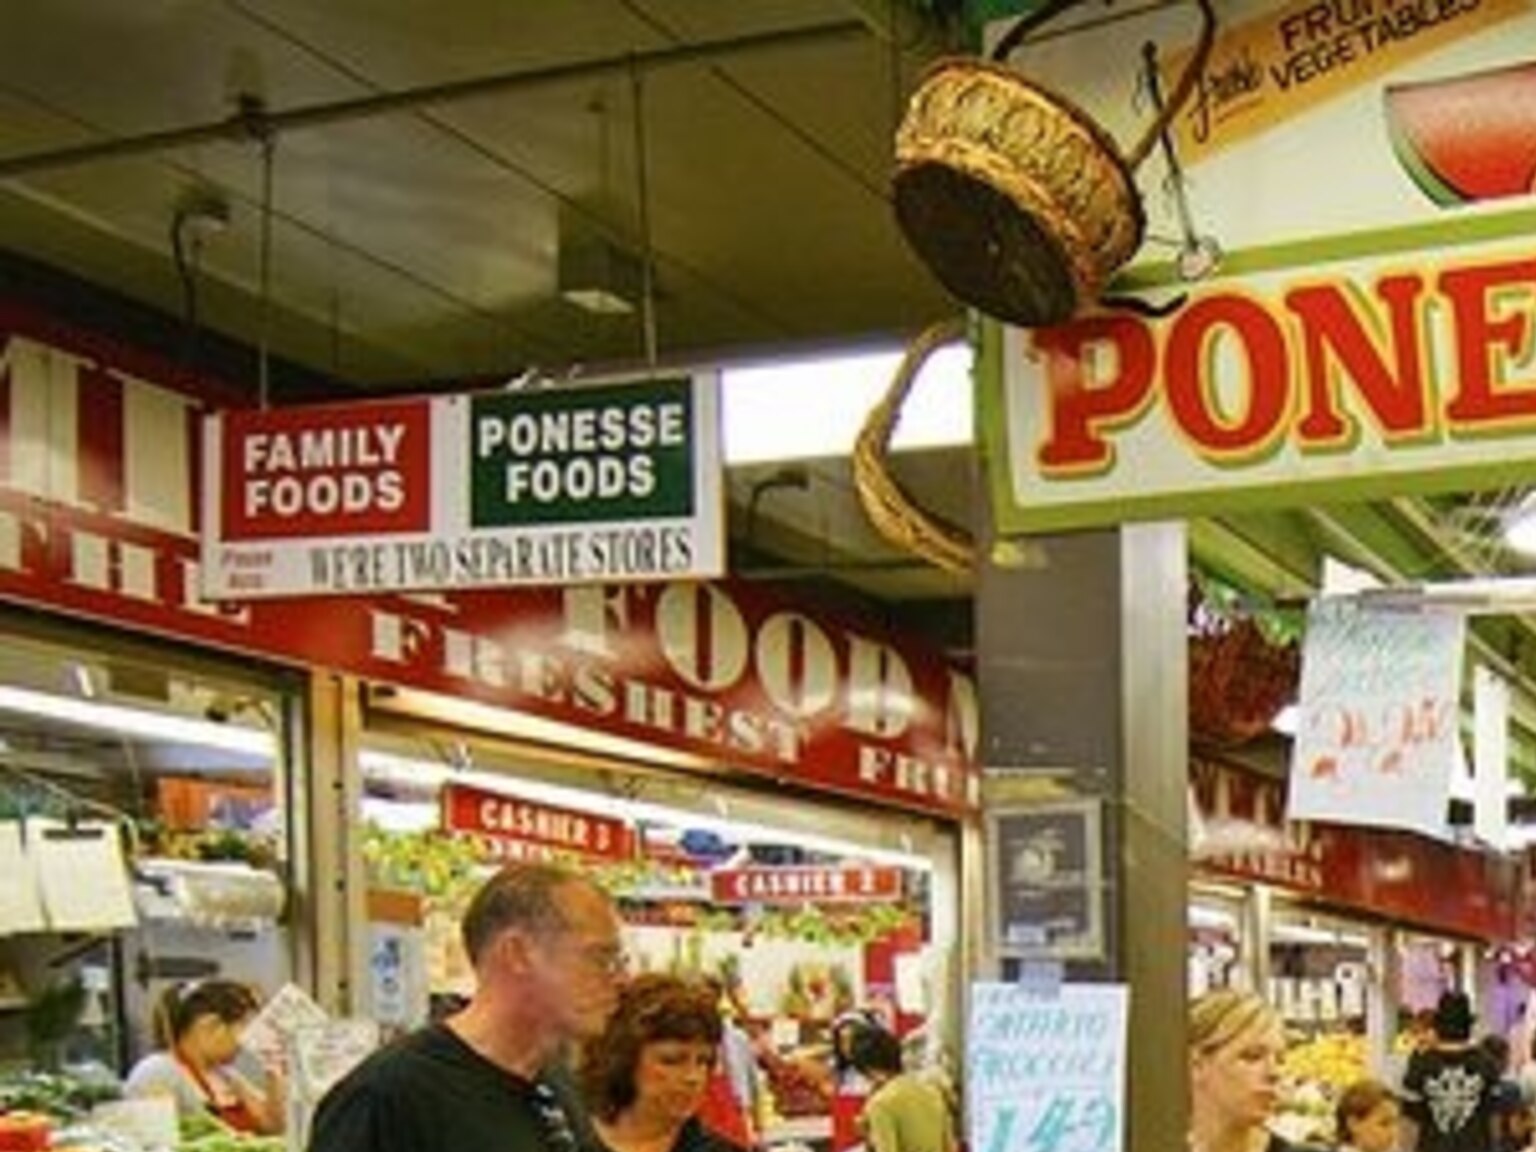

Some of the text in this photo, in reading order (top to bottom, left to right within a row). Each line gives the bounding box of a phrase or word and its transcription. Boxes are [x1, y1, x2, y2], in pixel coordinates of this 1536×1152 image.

[244, 424, 405, 473] FAMILY
[479, 404, 683, 457] PONESSE
[244, 471, 406, 518] FOODS
[506, 455, 656, 502] FOODS
[455, 531, 580, 583] SEPARATE
[587, 527, 694, 575] STORES
[734, 871, 845, 898] CASHIER
